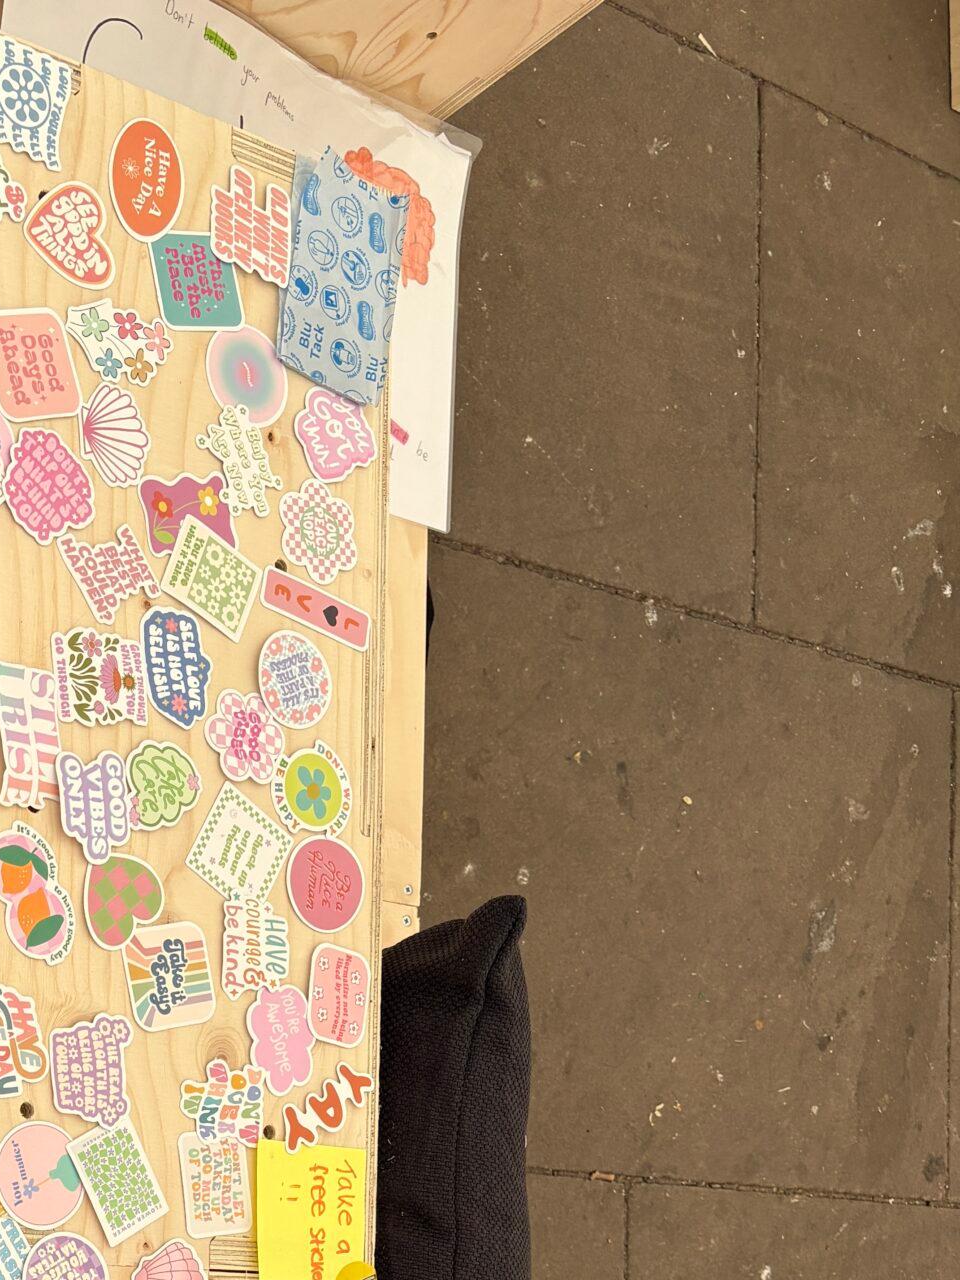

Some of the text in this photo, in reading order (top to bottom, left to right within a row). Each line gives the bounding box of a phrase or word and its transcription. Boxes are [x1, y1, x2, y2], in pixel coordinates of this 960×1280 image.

[241, 65, 260, 86] your
[265, 91, 294, 121] problems
[133, 138, 156, 214] Nice Day
[30, 217, 87, 278] THINGS
[215, 189, 233, 259] DOORS
[234, 169, 251, 270] OPEN NEW
[253, 210, 270, 278] WON'T
[271, 187, 288, 283] OLD WAYS
[299, 322, 312, 347] Blu
[309, 327, 325, 359] Tack
[247, 428, 272, 481] Enjoy
[61, 538, 112, 621] HAPPEN?
[79, 546, 118, 607] COULD
[94, 548, 126, 594] THAT
[104, 545, 135, 591] BEST
[120, 528, 160, 595] WHAT'S
[55, 637, 70, 718] GO THROUGH
[149, 625, 169, 698] SELFISH
[166, 634, 184, 693] IS NOT
[179, 620, 200, 711] SELF LOVE
[64, 758, 86, 833] ONLY
[86, 767, 106, 853] VIBES
[106, 757, 126, 836] GOOD
[275, 759, 300, 830] BE HAPPY
[316, 744, 350, 836] DON'T WORRY
[163, 939, 188, 1005] Take it
[225, 905, 244, 988] be kind
[243, 899, 267, 986] courage &
[150, 954, 172, 1015] Easy
[4, 992, 46, 1080] HAVE
[200, 1063, 228, 1140] THINK
[218, 1074, 247, 1133] OVER
[240, 1069, 261, 1143] DON'T
[285, 1065, 372, 1151] YAY
[220, 1138, 234, 1224] YESTERDAY
[310, 1164, 328, 1217] free
[336, 1160, 357, 1226] Take
[336, 1240, 352, 1254] a
